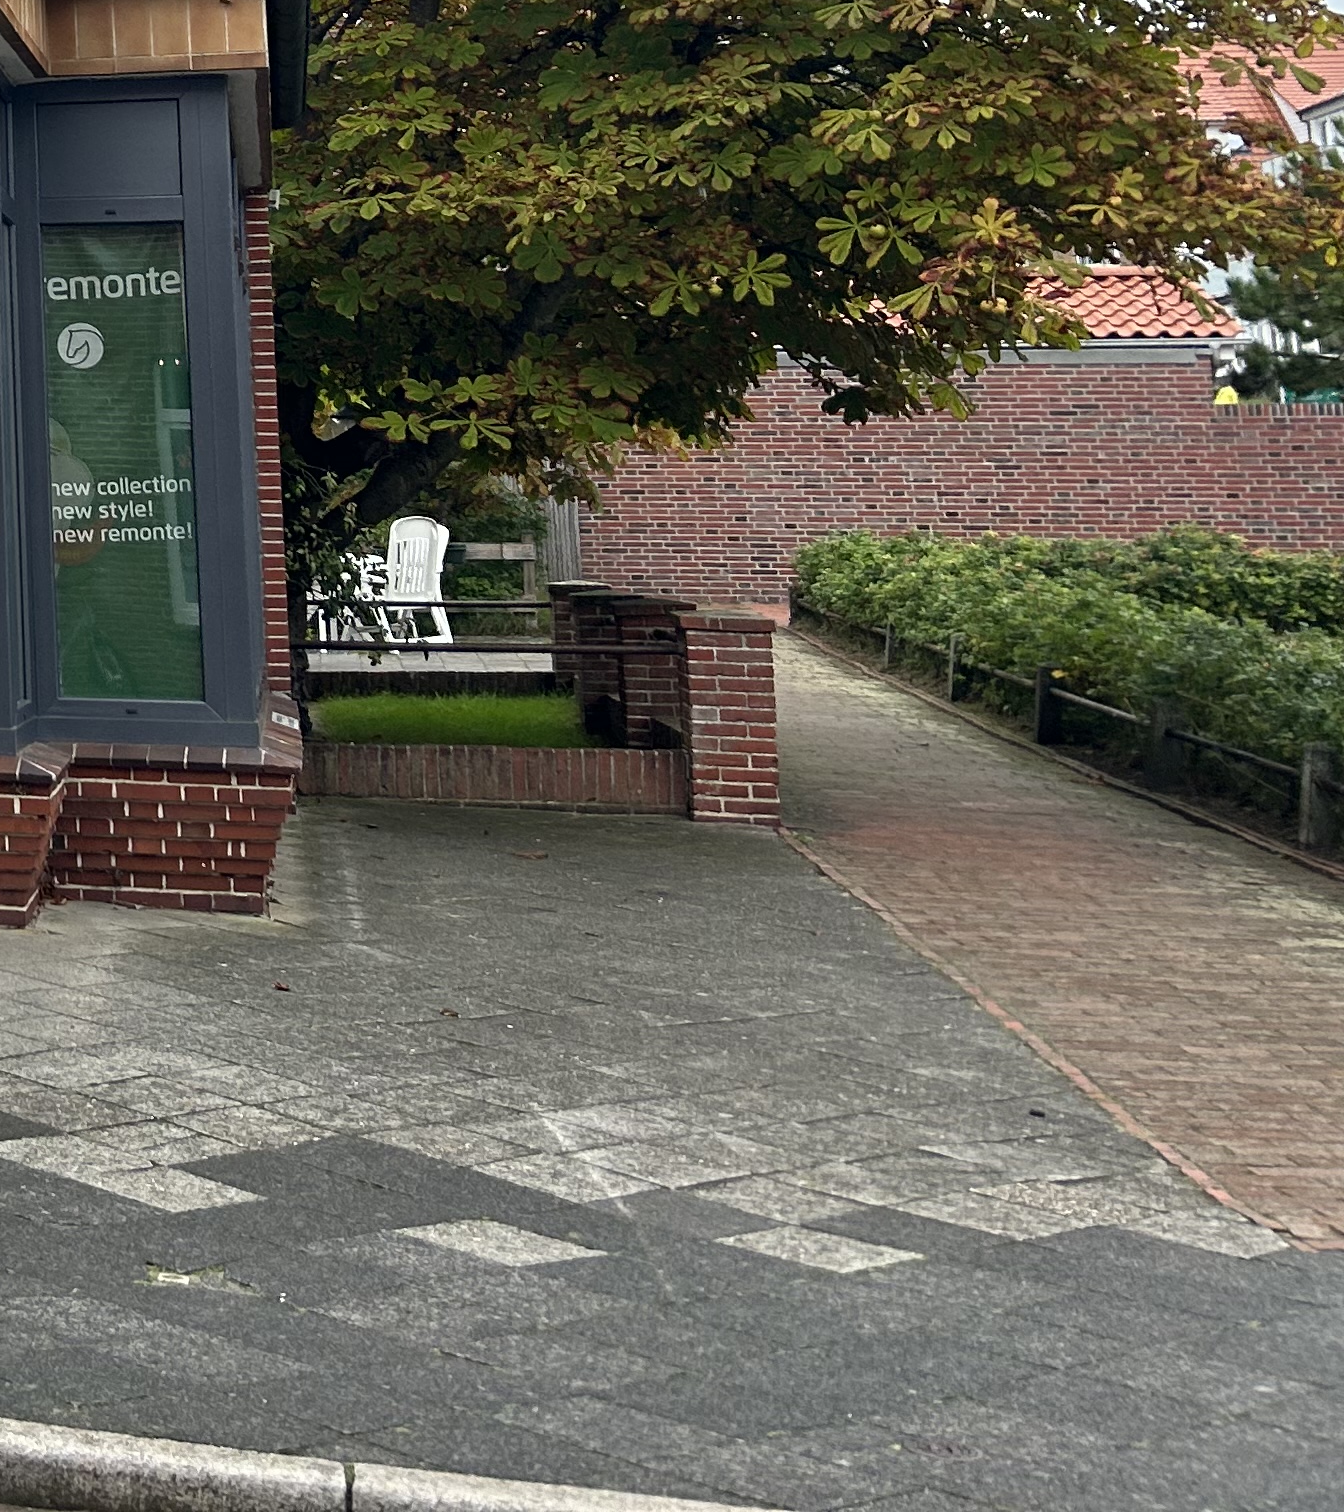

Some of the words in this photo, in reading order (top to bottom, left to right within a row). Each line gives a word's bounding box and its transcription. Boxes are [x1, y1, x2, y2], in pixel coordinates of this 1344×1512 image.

[43, 266, 181, 301] emonte
[51, 482, 91, 497] new
[97, 474, 192, 496] collection
[52, 504, 92, 520] new
[98, 500, 154, 522] style!
[53, 528, 94, 543] new
[100, 522, 193, 543] remonte!
